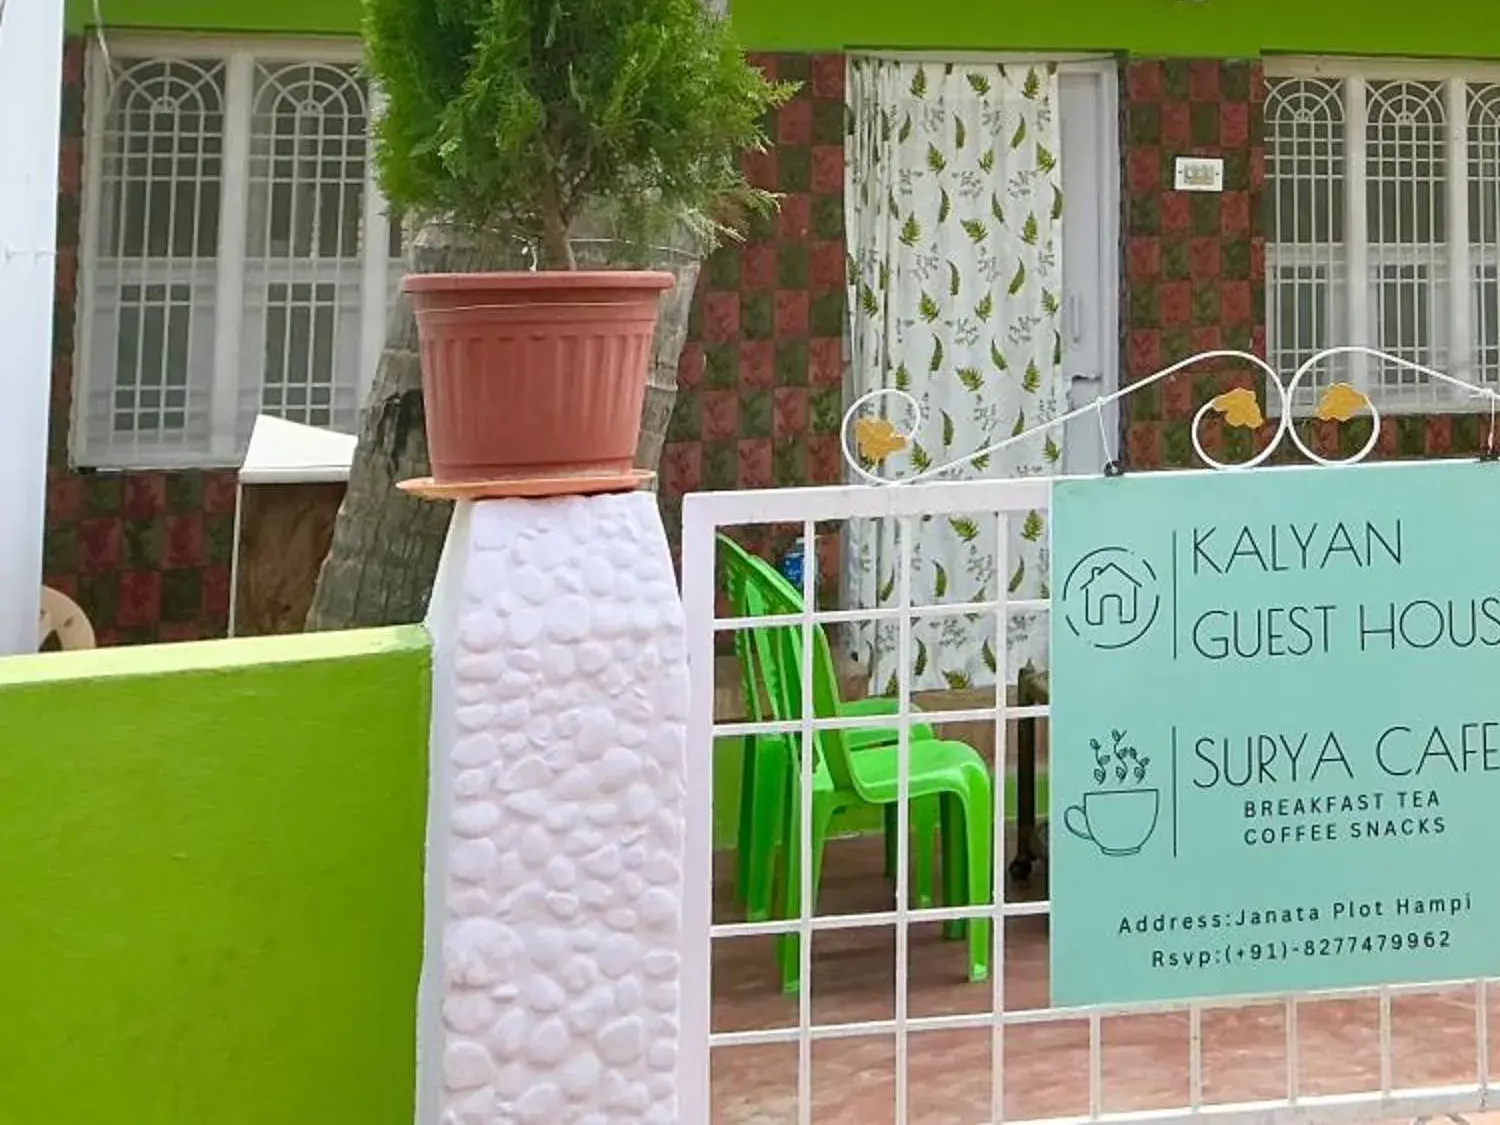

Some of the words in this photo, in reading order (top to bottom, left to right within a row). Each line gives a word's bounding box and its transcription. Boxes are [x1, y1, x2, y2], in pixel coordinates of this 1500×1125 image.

[1192, 518, 1402, 575] KALYAN
[1191, 604, 1338, 660] GUEST
[1192, 730, 1355, 789] SURYA
[1243, 792, 1384, 819] BREAKFAST
[1396, 789, 1440, 809] TEA
[1243, 822, 1337, 846] COFFEE
[1349, 816, 1446, 841] SNACKS
[1332, 900, 1384, 920] Plot
[1396, 892, 1472, 916] Hampi
